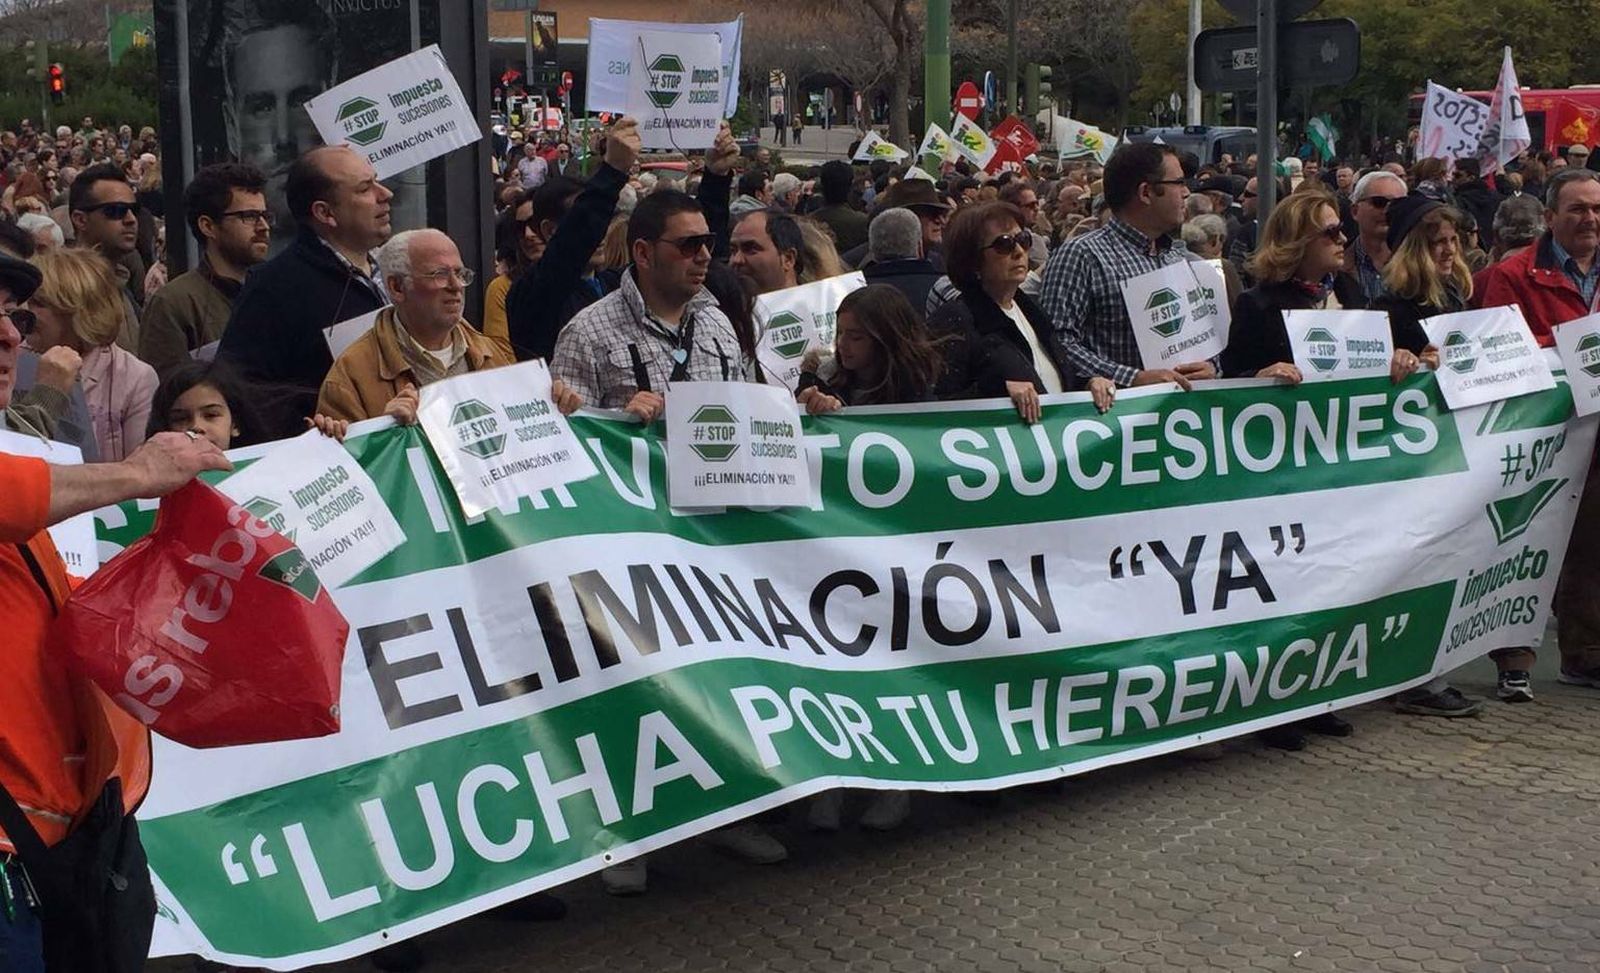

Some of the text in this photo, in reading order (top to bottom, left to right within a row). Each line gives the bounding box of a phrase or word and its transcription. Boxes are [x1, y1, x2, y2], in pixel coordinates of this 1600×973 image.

[387, 77, 443, 108] impuesto
[397, 94, 453, 125] sucesiones
[367, 130, 433, 165] ¡ELIMINACIÓN
[501, 397, 551, 424] impuesto
[750, 416, 794, 440] impuesto
[514, 419, 562, 443] sucesiones
[751, 440, 798, 460] sucesiones
[939, 389, 1440, 501] SUCESIONES
[289, 464, 350, 509] impuesto
[306, 486, 365, 532] sucesiones
[310, 538, 354, 570] NACIÓN
[160, 504, 275, 655] reba
[1459, 545, 1549, 608] impuesto
[357, 522, 1305, 731] ELIMINACIÓN “YA”
[1446, 594, 1539, 654] sucesiones
[731, 684, 899, 770] POR
[879, 689, 980, 767] TU
